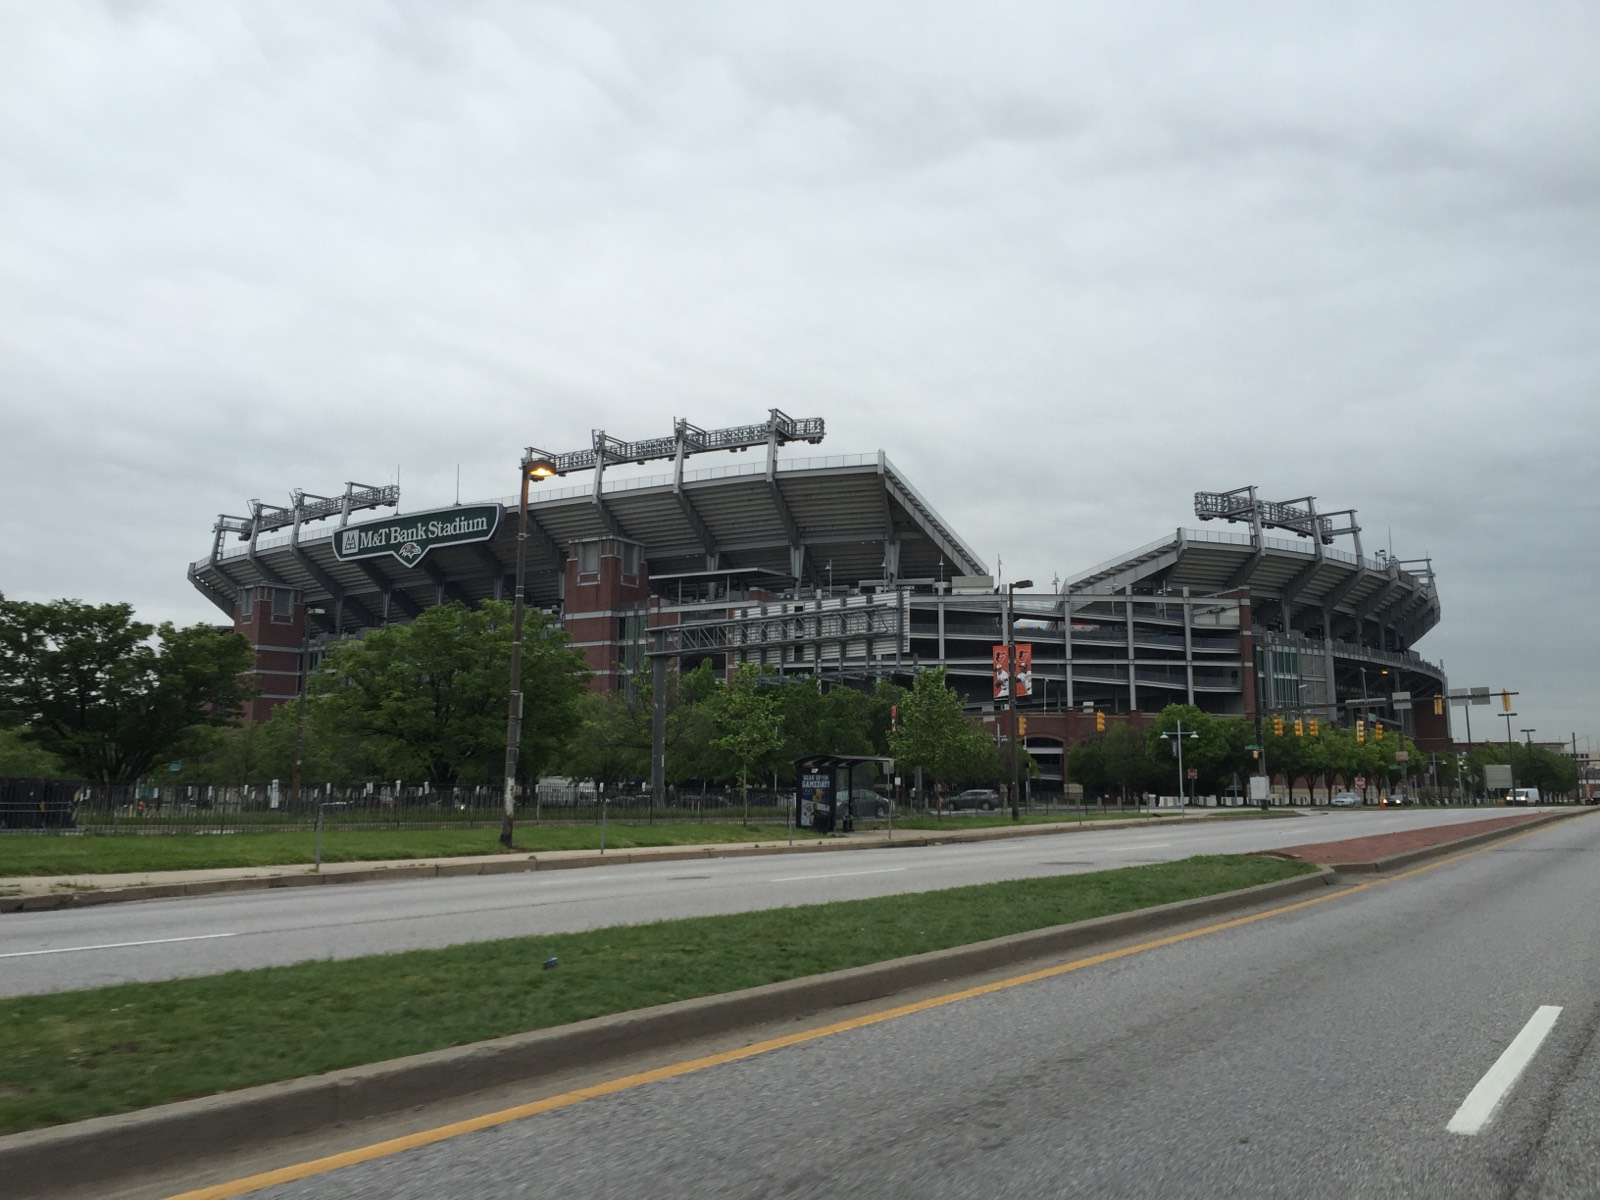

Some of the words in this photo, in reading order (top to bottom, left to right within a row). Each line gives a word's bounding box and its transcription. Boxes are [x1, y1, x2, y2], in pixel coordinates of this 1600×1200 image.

[360, 528, 389, 549] M&T
[390, 522, 427, 544] Bank
[428, 516, 488, 538] Stadium
